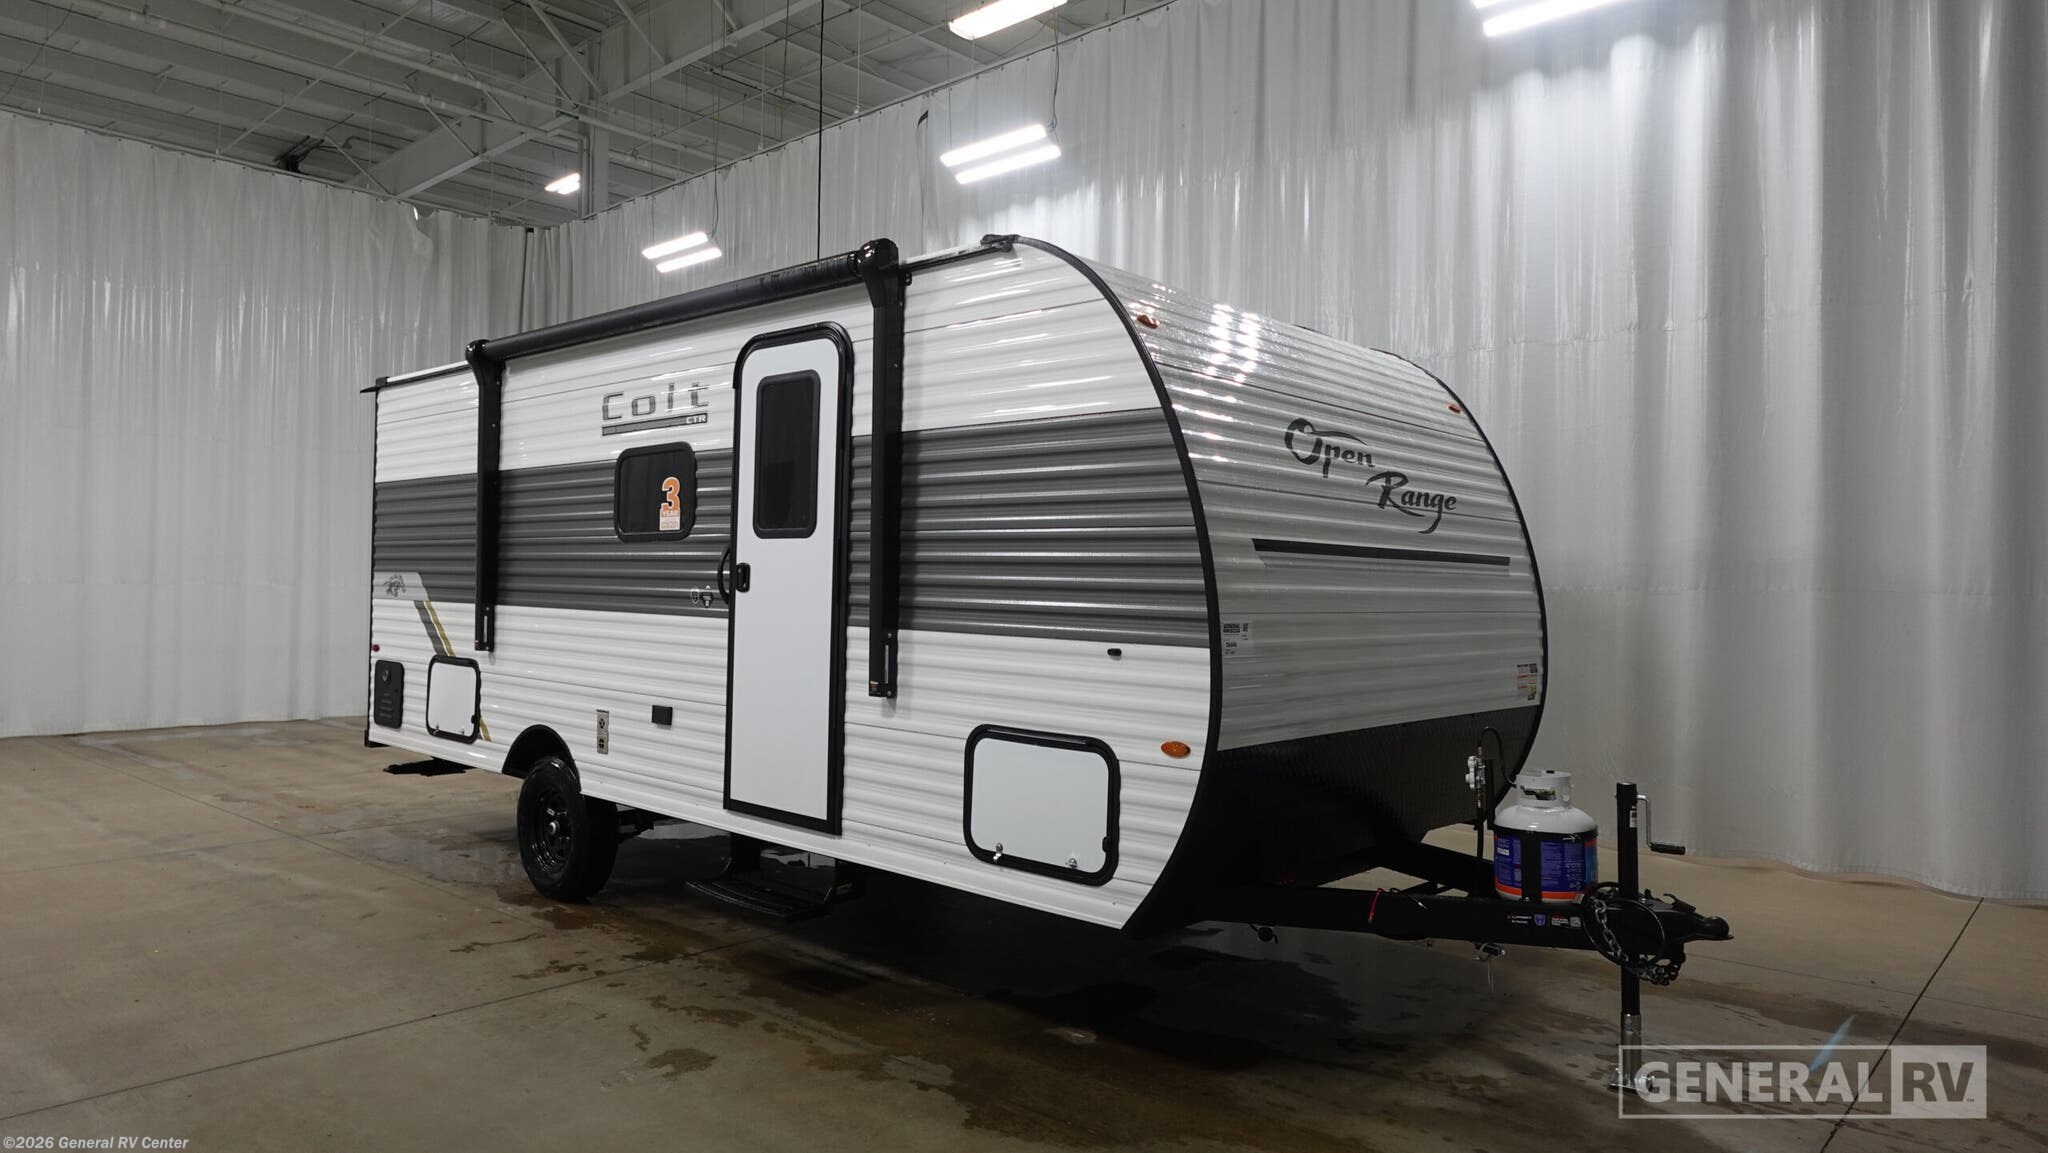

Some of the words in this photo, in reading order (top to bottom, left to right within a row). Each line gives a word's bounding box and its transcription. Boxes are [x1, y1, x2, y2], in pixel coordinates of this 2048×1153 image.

[602, 382, 709, 420] Colt
[686, 414, 706, 424] CTR
[1284, 418, 1375, 478] Open
[662, 476, 680, 510] 3
[1365, 471, 1457, 534] Range
